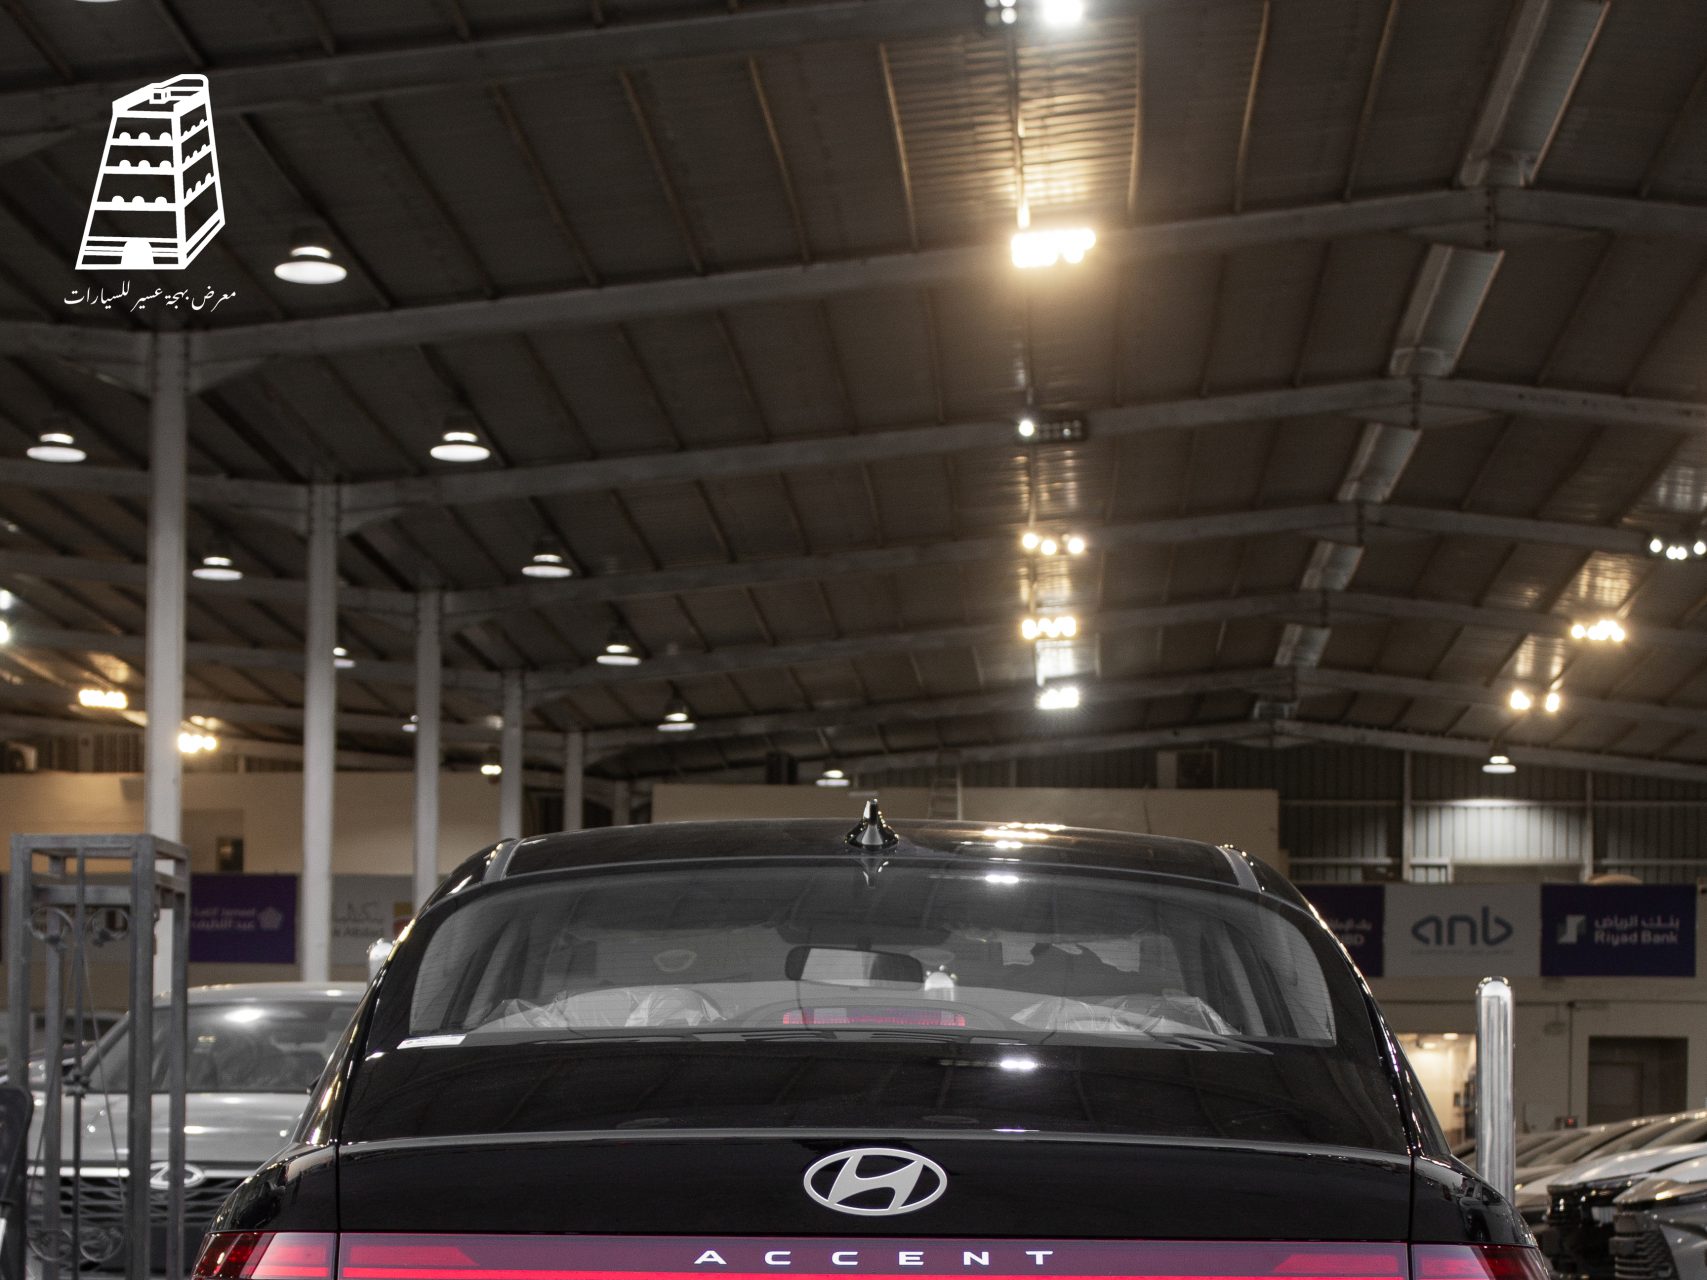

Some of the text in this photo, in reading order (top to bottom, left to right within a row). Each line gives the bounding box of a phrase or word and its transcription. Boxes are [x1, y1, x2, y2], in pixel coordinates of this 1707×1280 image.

[1411, 906, 1514, 946] anb
[1594, 930, 1679, 947] Riyad Bank
[694, 1250, 1054, 1266] ACCENT
